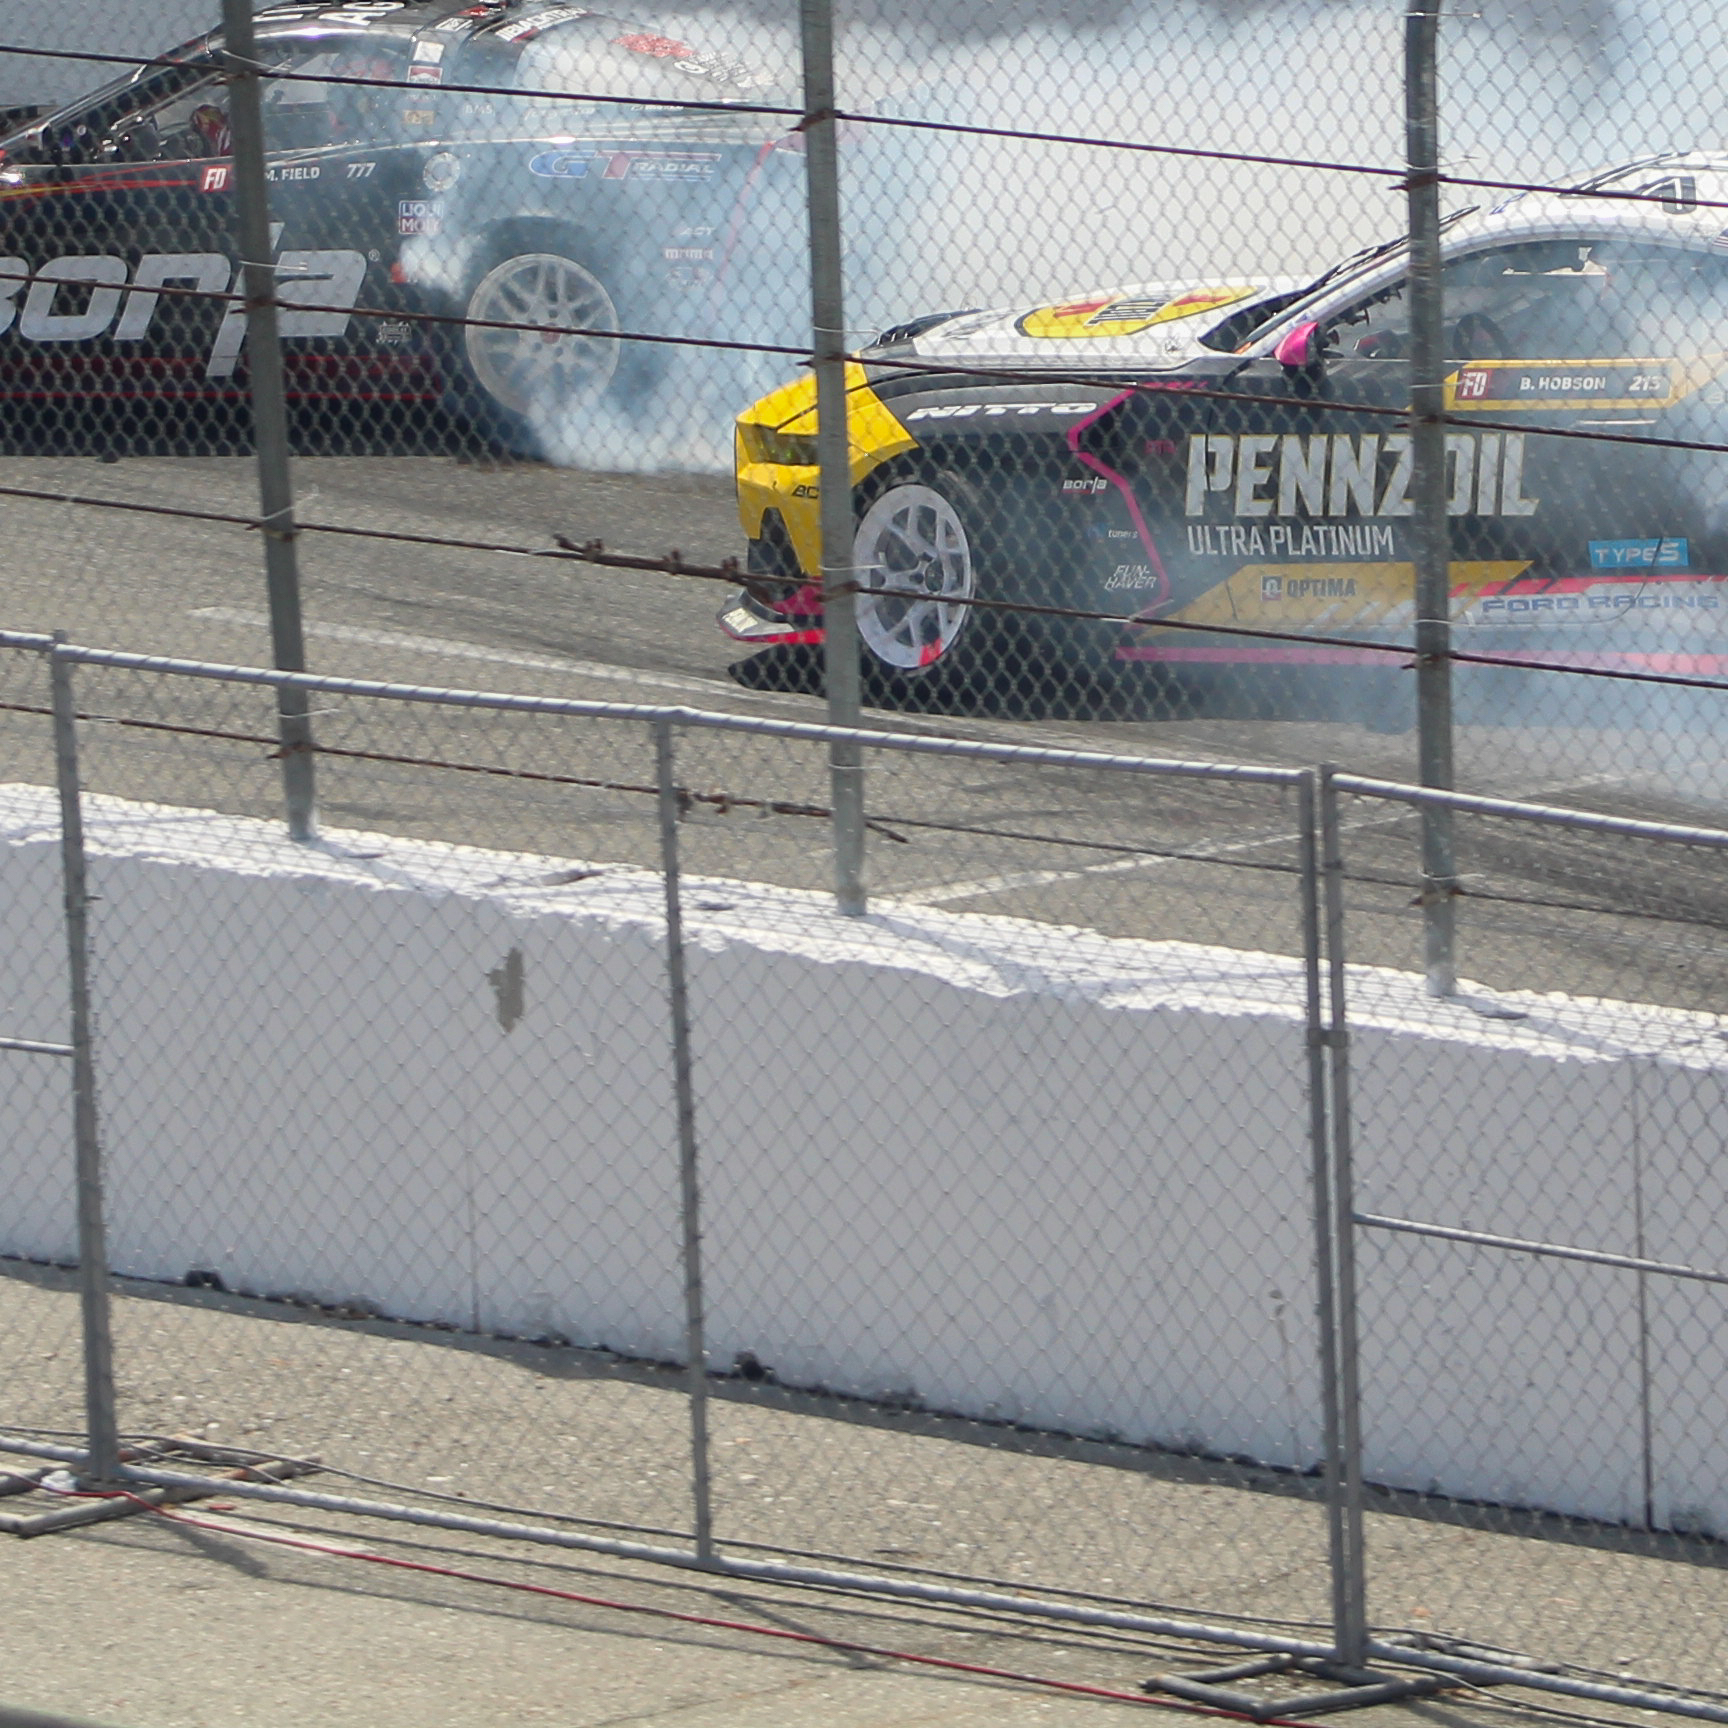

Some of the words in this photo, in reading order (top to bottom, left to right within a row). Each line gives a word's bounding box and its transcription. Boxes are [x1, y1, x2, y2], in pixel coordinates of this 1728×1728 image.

[203, 166, 228, 190] FD
[281, 167, 321, 181] FIELD
[346, 162, 377, 178] 777
[633, 161, 716, 174] RADIAL
[1461, 371, 1489, 397] FD
[1519, 379, 1535, 391] B.
[1538, 376, 1607, 391] HOBSON
[906, 402, 1098, 421] NITTO
[1186, 525, 1266, 557] ULTRA
[1271, 524, 1395, 557] PLATINUM
[1286, 576, 1358, 599] OPTIMA
[1482, 598, 1579, 614] FORD
[1588, 595, 1720, 611] RACING
